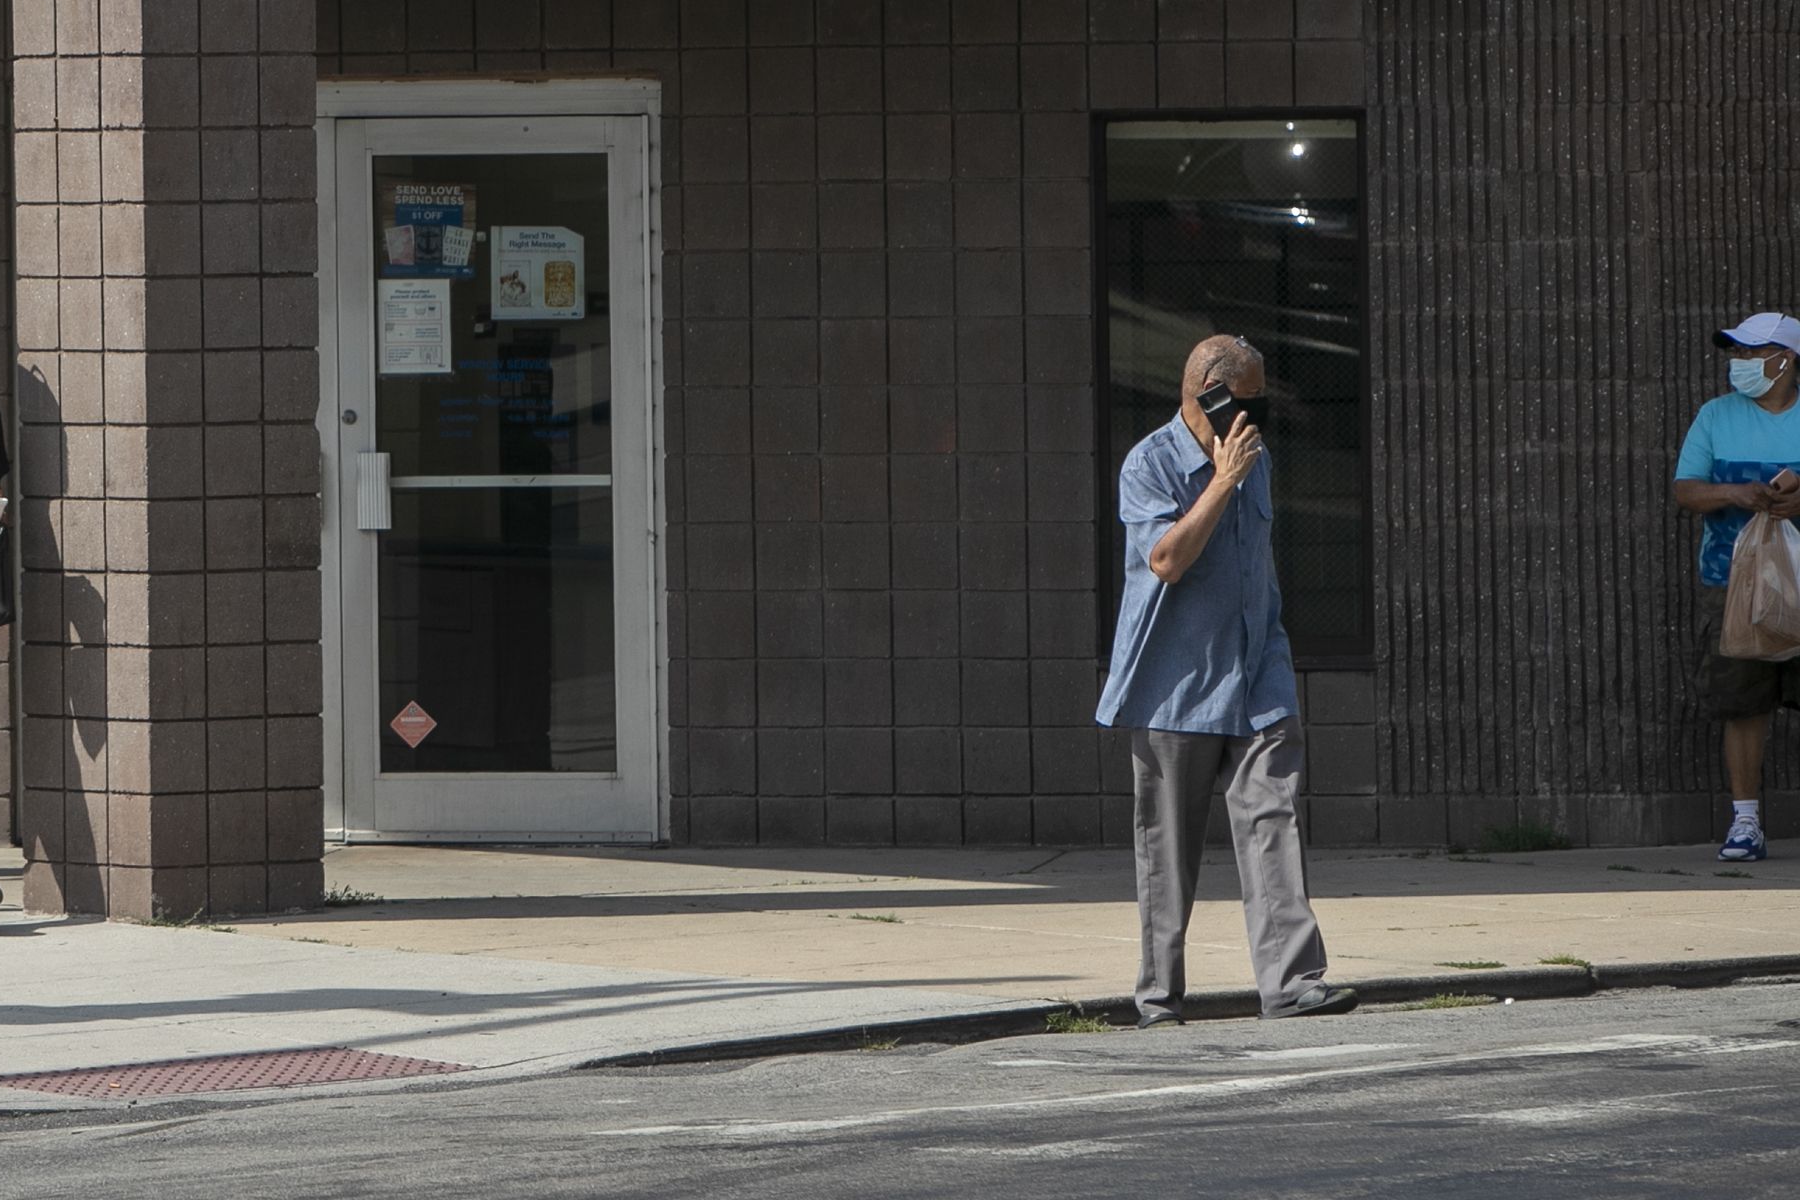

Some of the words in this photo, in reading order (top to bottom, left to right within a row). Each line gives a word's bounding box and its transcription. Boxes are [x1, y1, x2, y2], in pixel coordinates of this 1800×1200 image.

[395, 185, 427, 195] SEND
[394, 195, 433, 204] SPEND
[436, 196, 465, 205] LESS
[412, 211, 421, 220] $1
[423, 211, 444, 220] OFF
[519, 232, 539, 240] Send
[509, 240, 529, 249] Right
[531, 240, 567, 250] Message
